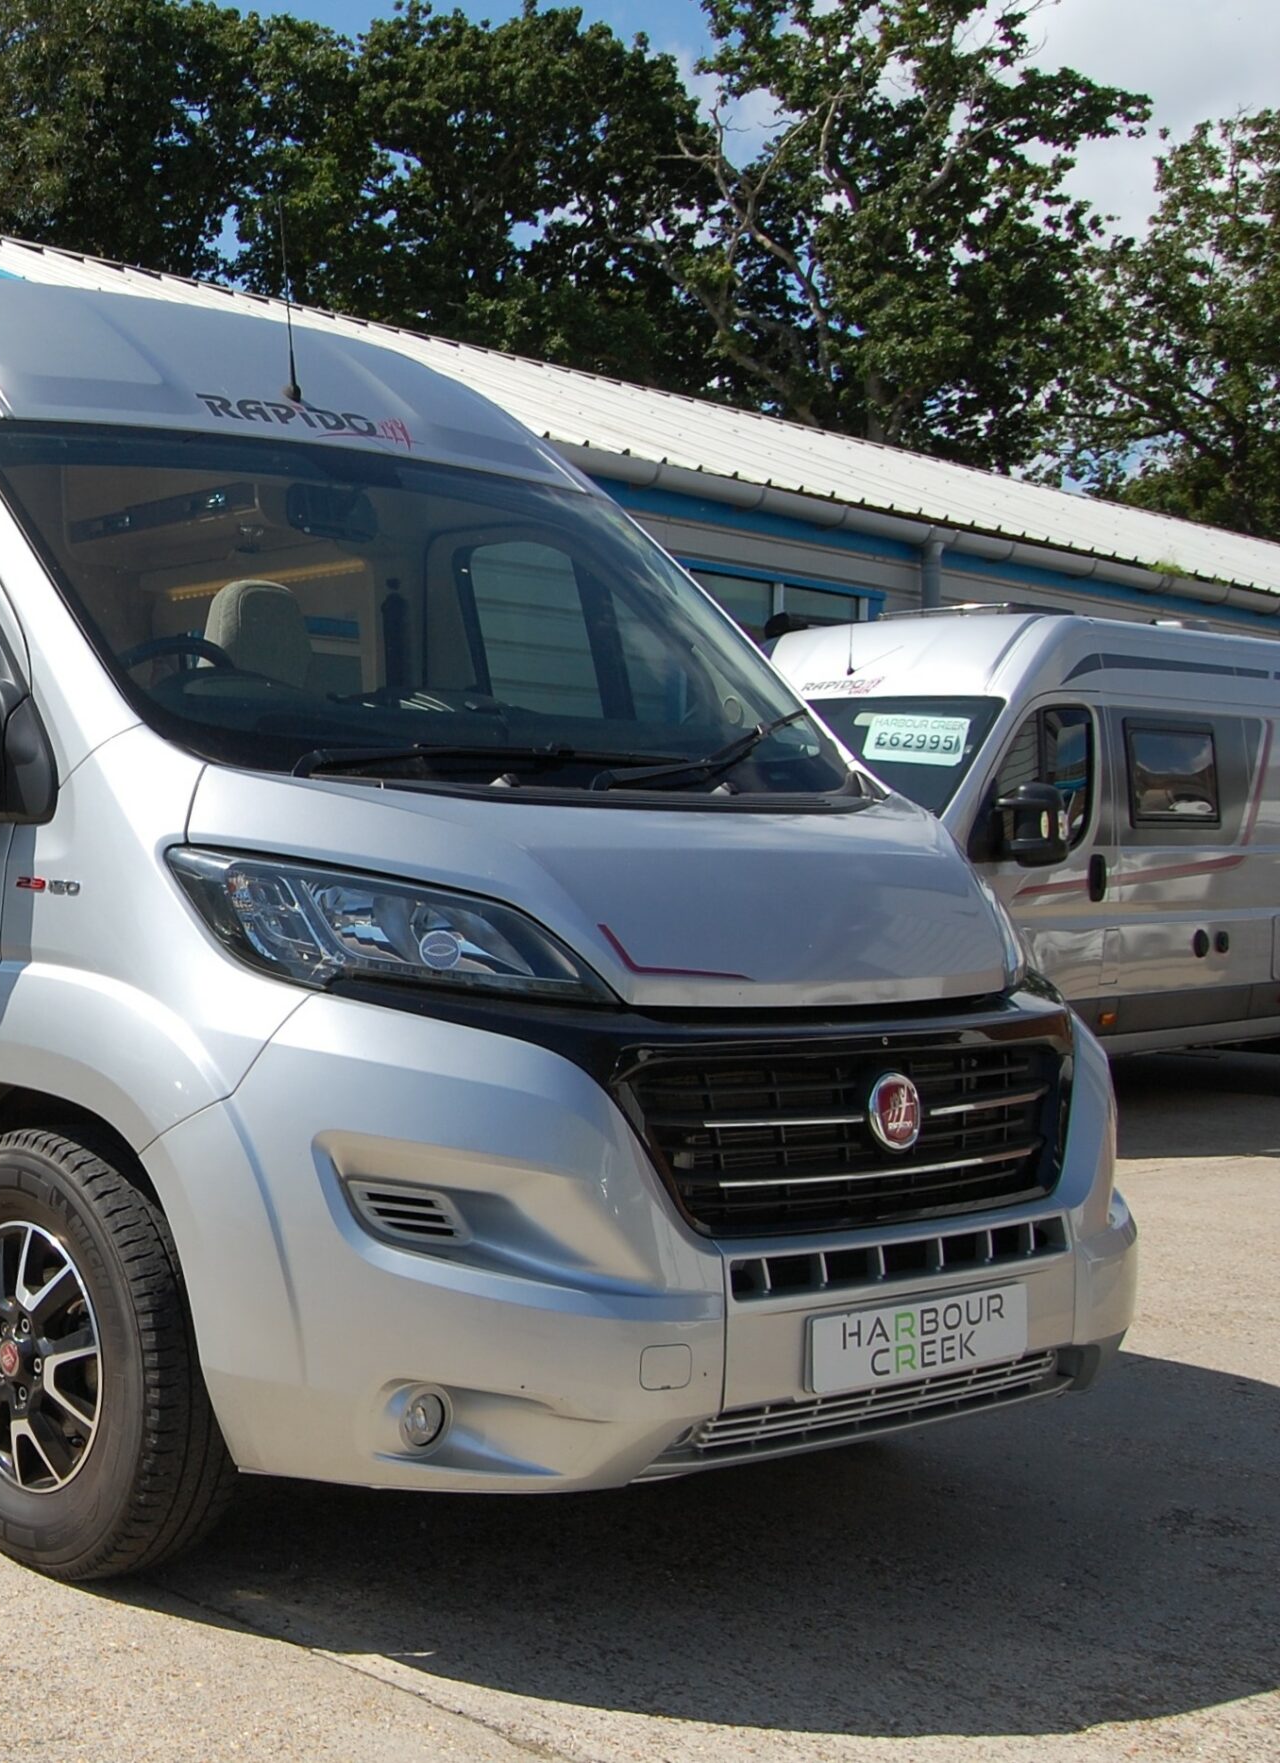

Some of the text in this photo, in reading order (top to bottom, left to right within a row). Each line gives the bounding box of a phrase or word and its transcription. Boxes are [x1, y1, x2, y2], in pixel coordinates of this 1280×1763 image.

[801, 679, 866, 691] RAPIDO
[875, 718, 967, 731] HARBOUR CREEK
[876, 732, 954, 751] £62995
[842, 1293, 1004, 1350] HARBOUR
[871, 1330, 976, 1376] CREEK
